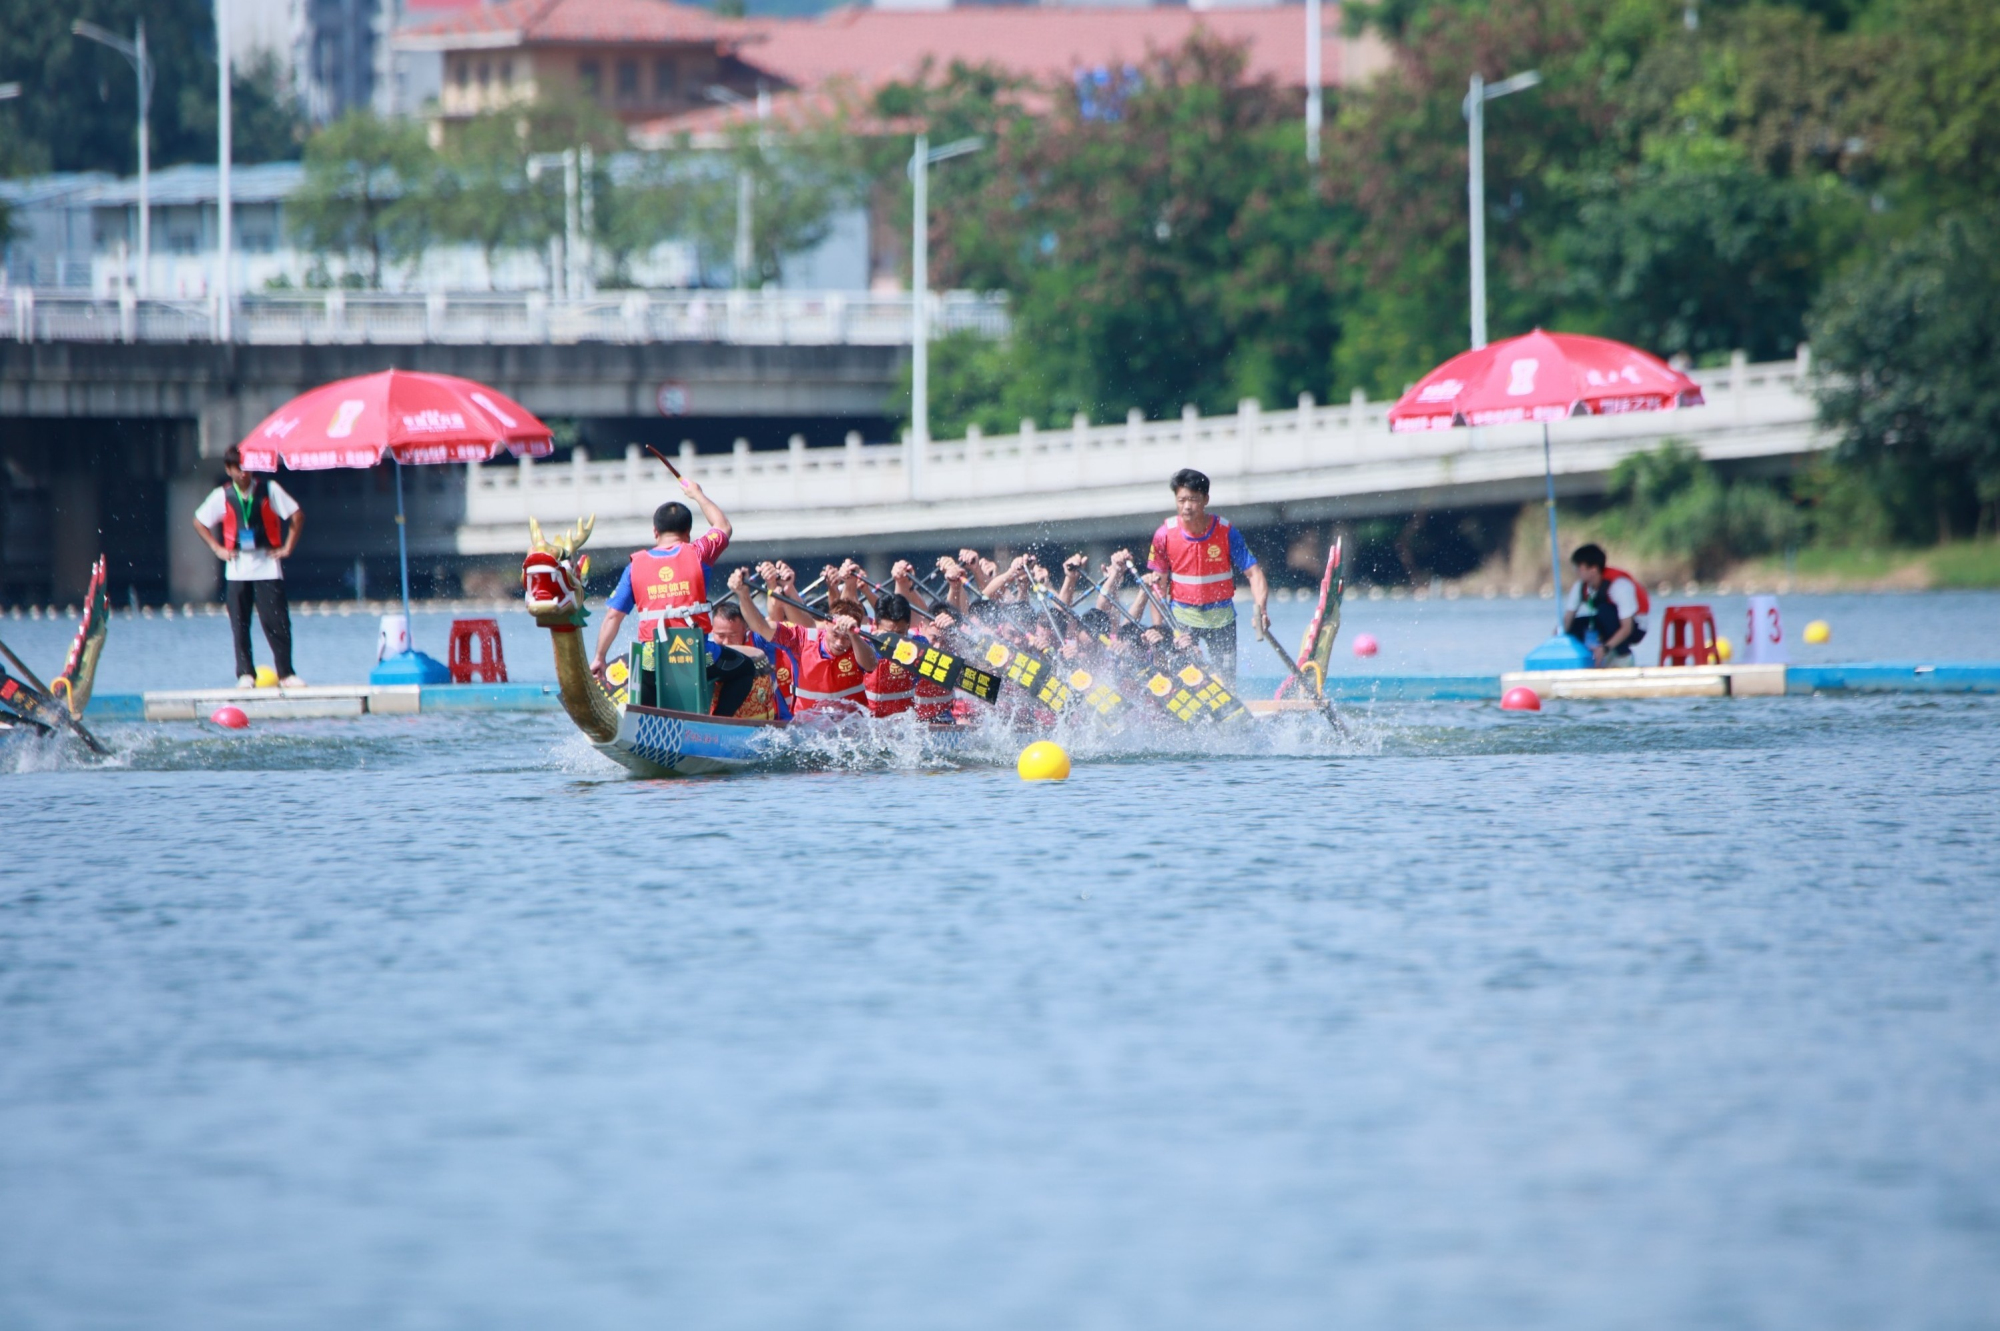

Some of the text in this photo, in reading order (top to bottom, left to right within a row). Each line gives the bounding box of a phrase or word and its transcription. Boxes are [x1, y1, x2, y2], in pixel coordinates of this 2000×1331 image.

[667, 590, 690, 598] SPORTS
[1768, 607, 1782, 643] 3
[631, 653, 640, 704] 4
